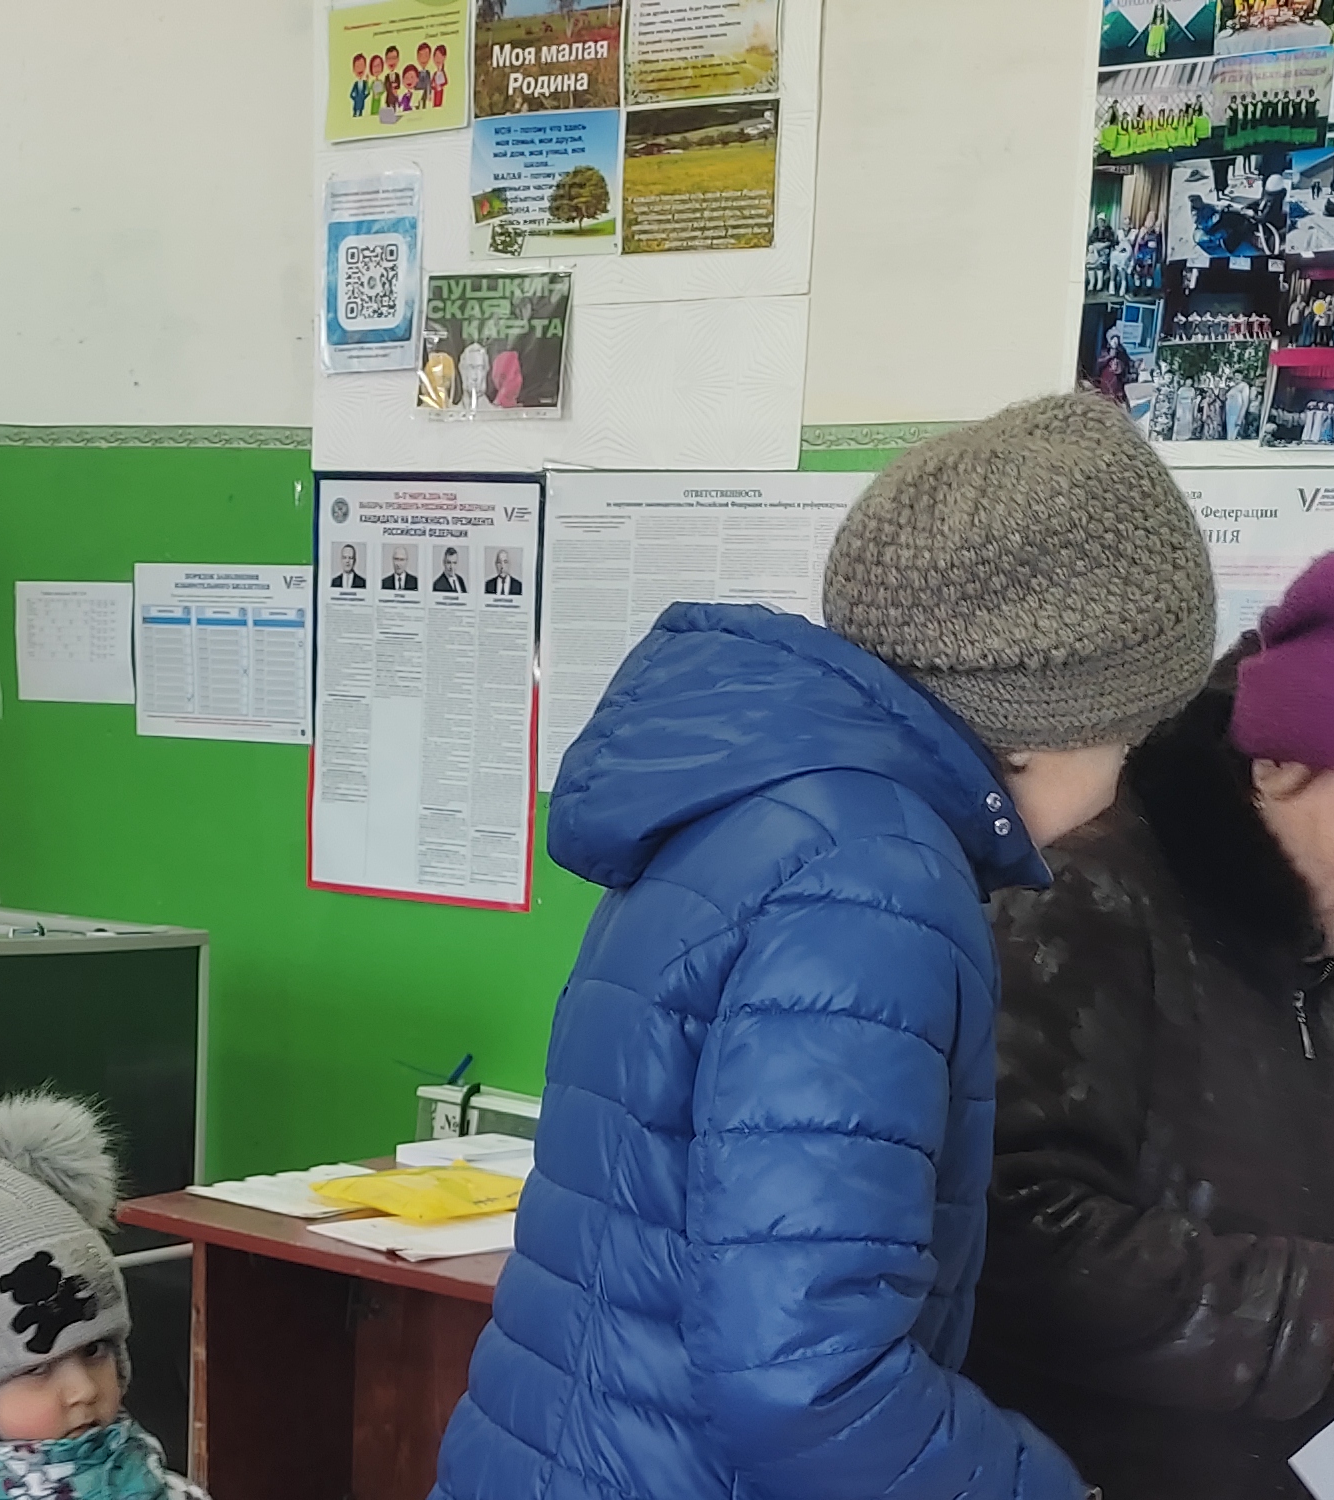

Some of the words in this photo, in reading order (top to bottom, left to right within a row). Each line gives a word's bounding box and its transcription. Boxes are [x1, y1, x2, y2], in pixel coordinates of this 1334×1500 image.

[491, 44, 540, 68] Моя
[541, 40, 609, 63] малая
[508, 72, 590, 98] Родина
[428, 299, 511, 319] СКАЯ
[462, 319, 563, 339] КАРТА
[683, 489, 763, 498] ОТВЕТСТВЕННОСТЬ
[1200, 505, 1278, 522] Федерации
